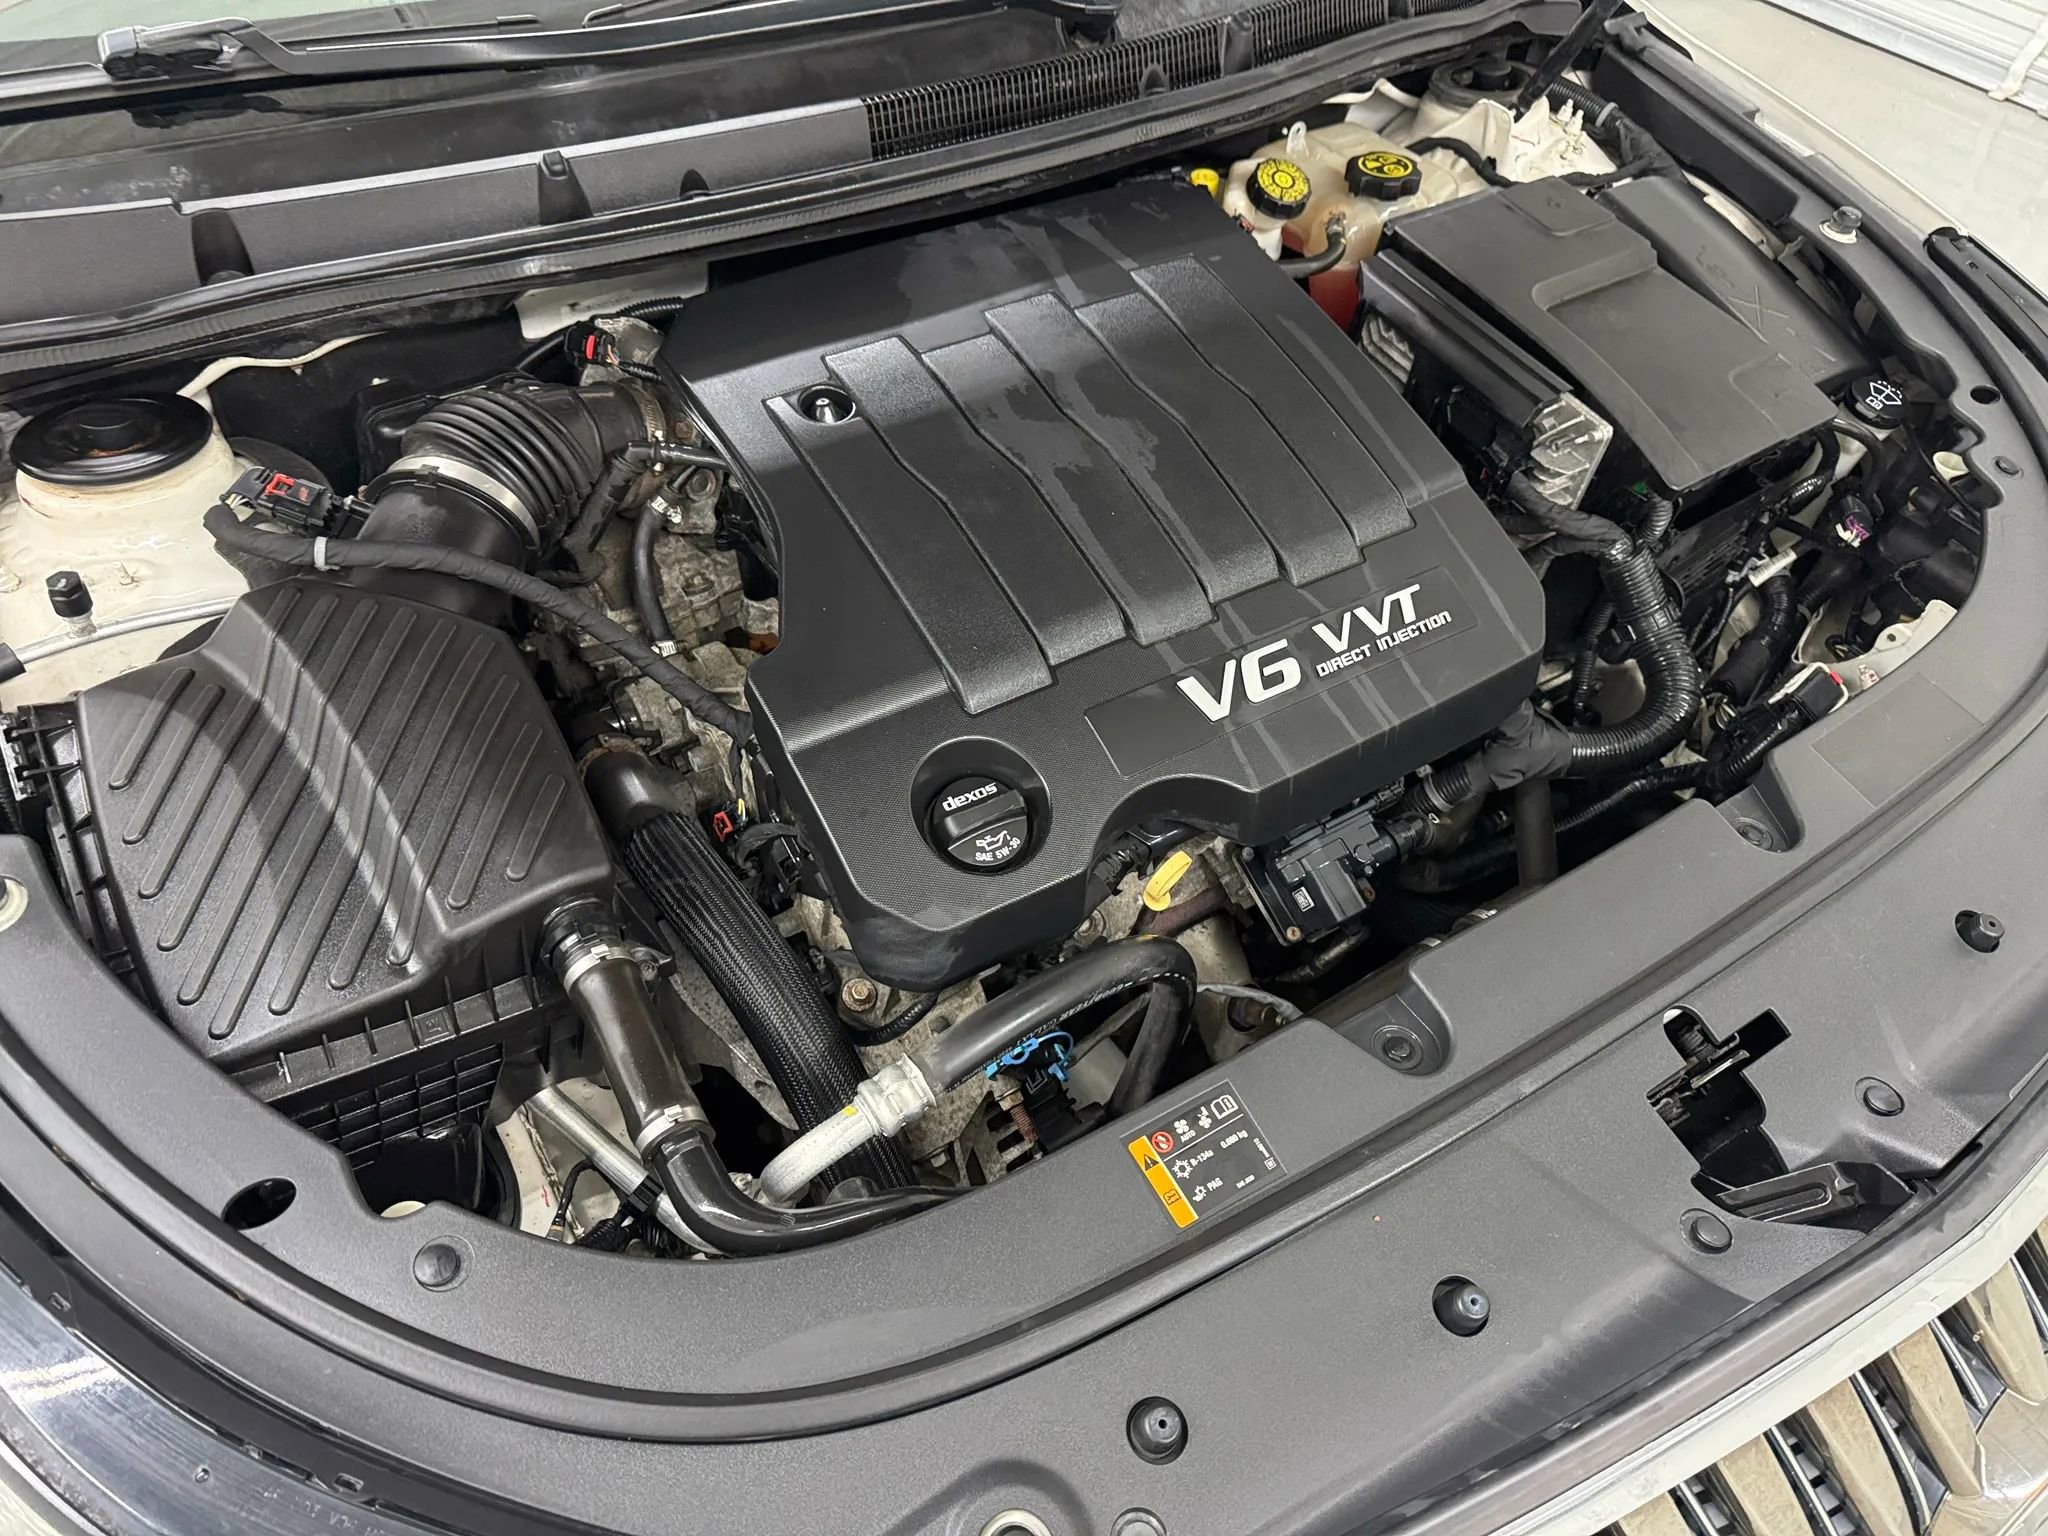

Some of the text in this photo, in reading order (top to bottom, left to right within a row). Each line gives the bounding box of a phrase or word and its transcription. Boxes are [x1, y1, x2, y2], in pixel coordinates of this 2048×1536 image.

[1311, 583, 1420, 654] VVT
[1315, 610, 1452, 678] DIRECT INJECTION
[1176, 638, 1302, 724] V6
[942, 782, 998, 811] dexos
[975, 837, 1021, 861] SAE 5W-30
[1180, 1129, 1196, 1143] AUTO
[1190, 1149, 1214, 1167] R-134a
[1206, 1177, 1223, 1192] PAG
